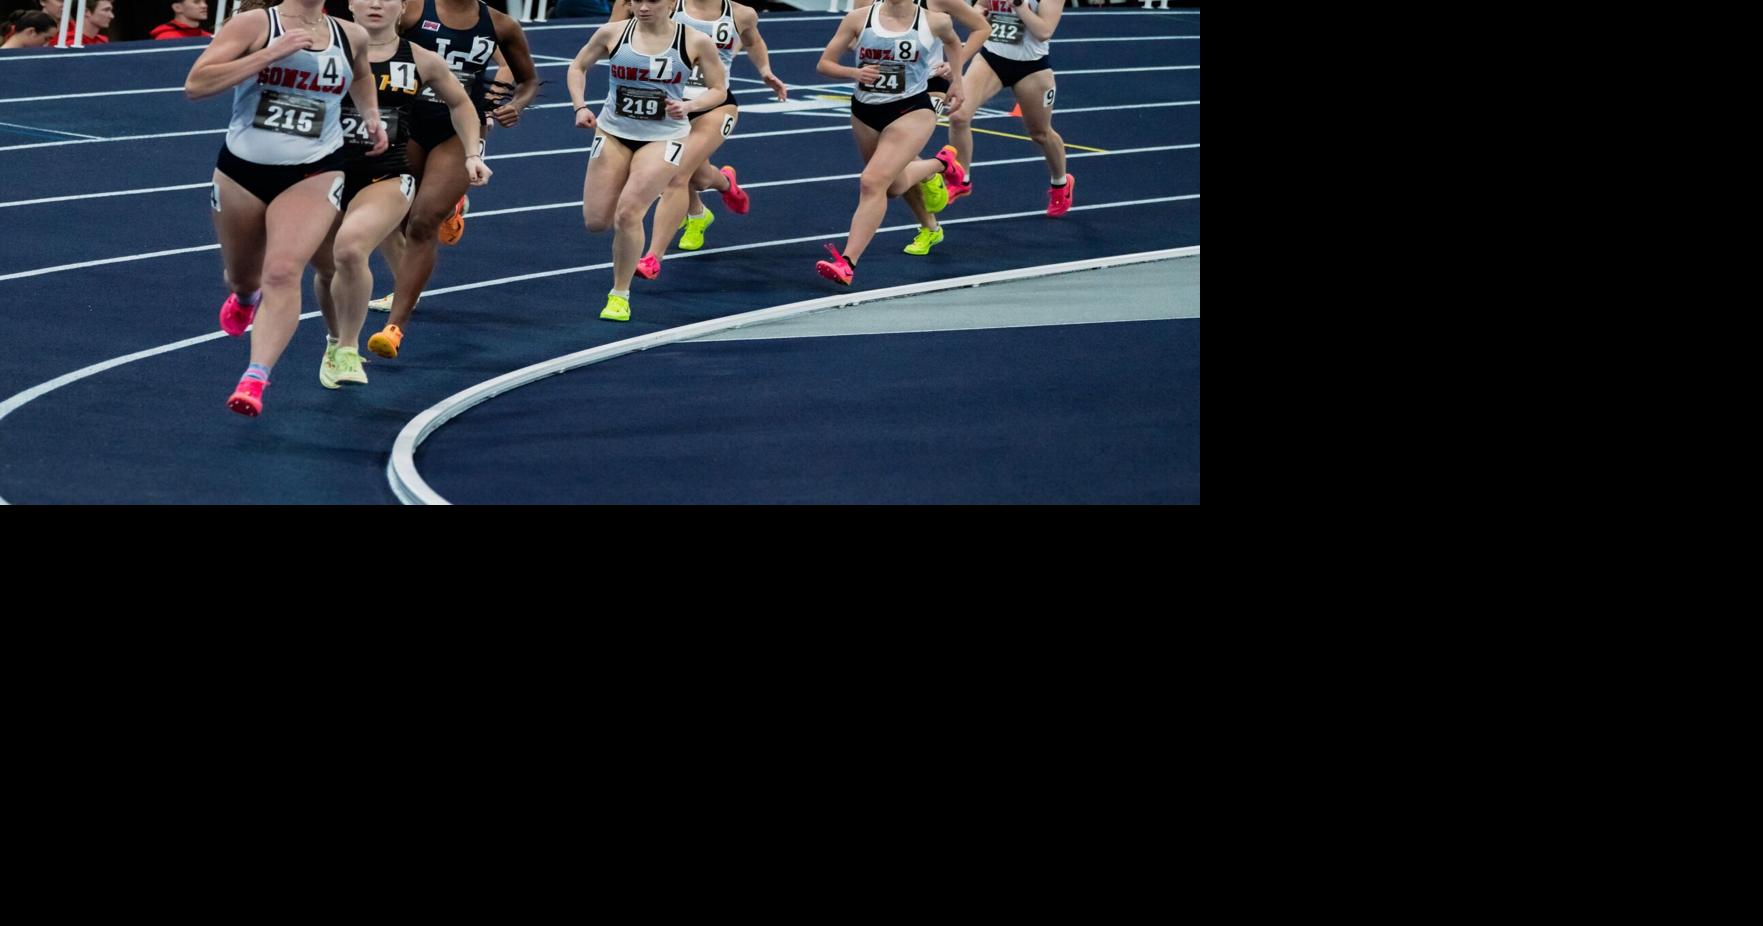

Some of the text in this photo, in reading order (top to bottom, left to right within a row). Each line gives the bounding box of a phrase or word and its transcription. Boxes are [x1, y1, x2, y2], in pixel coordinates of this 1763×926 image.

[716, 22, 729, 42] 6
[990, 22, 1018, 40] 212
[472, 40, 489, 63] 2
[899, 40, 912, 60] 8
[322, 57, 339, 84] 4
[397, 63, 408, 87] 1
[655, 58, 668, 78] 7
[864, 74, 899, 90] 24
[622, 97, 658, 116] 219
[1046, 89, 1055, 105] 9
[263, 105, 315, 132] 215
[342, 117, 388, 139] 24
[723, 117, 734, 136] 6
[592, 136, 602, 157] 7
[671, 142, 682, 162] 7
